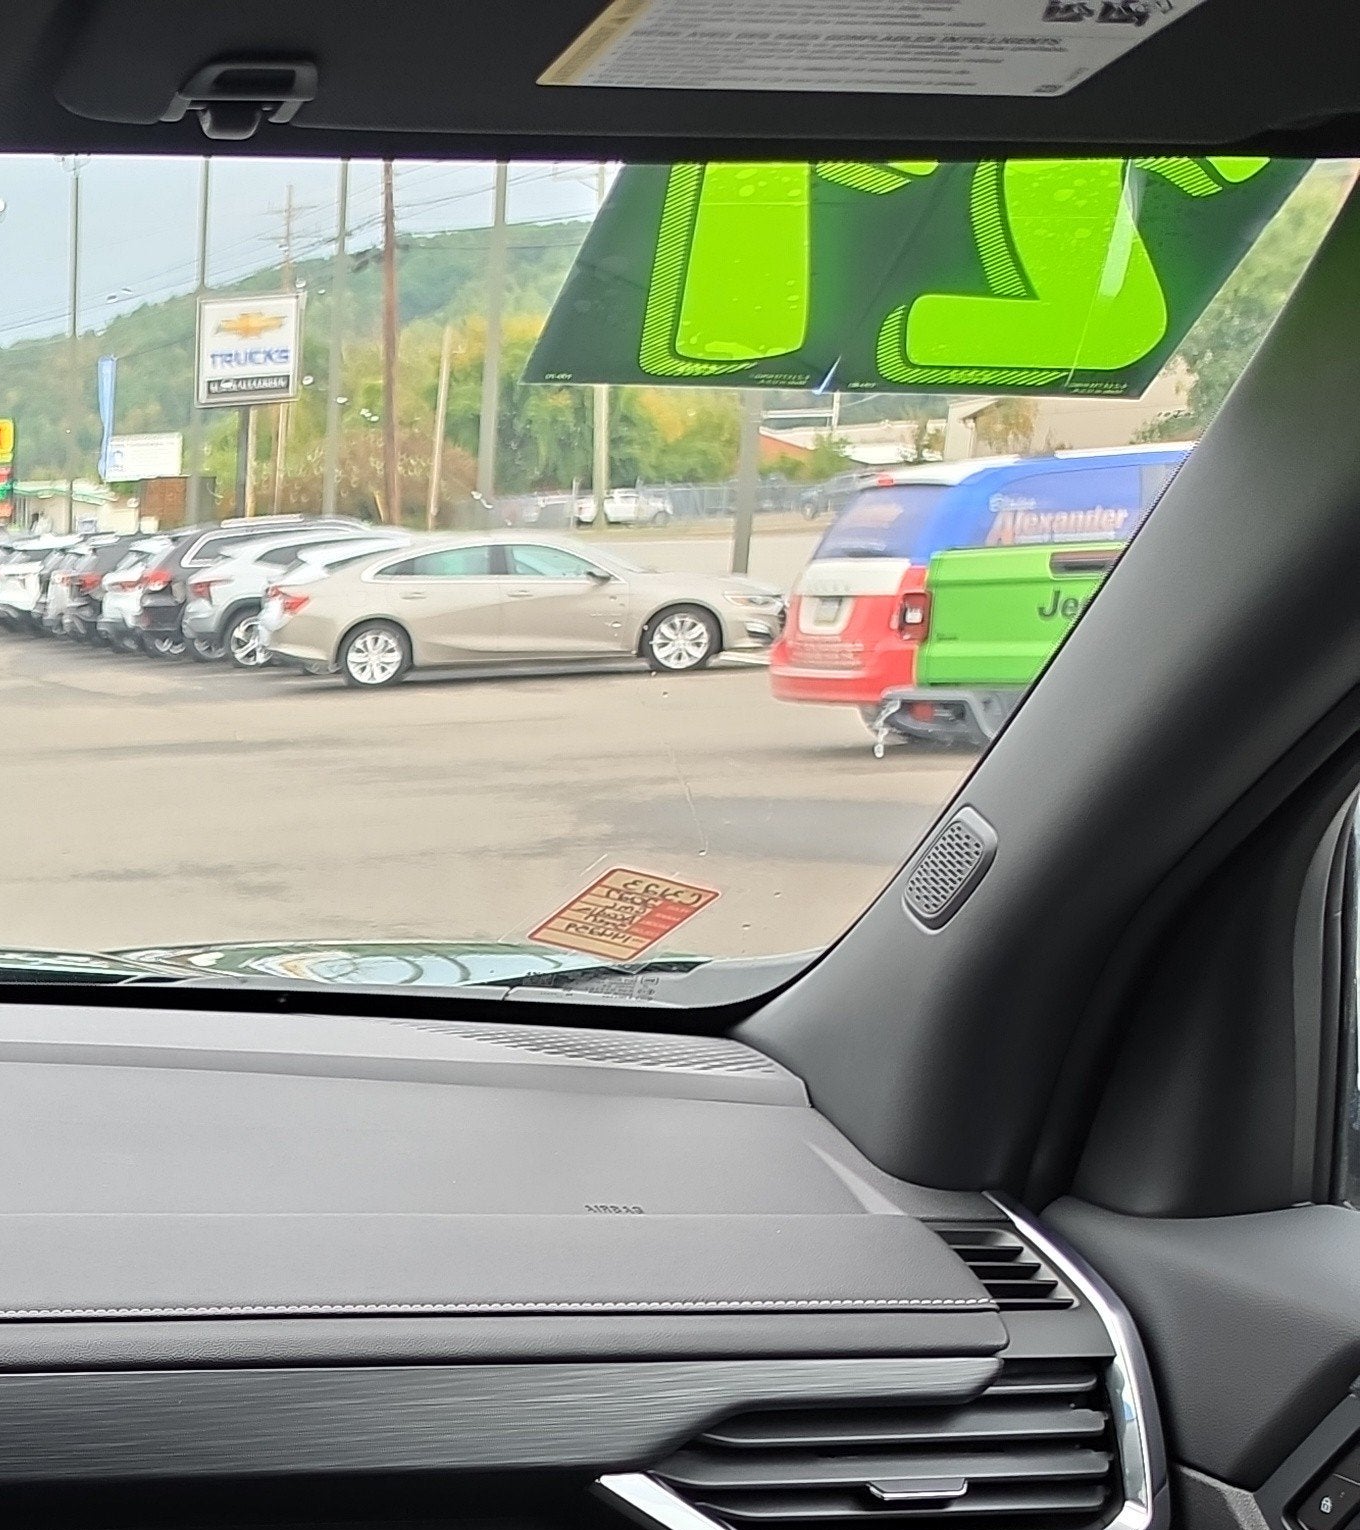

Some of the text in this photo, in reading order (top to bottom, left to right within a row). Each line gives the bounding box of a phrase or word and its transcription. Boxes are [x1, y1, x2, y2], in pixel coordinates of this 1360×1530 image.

[210, 348, 289, 367] TRUCKS
[1037, 588, 1080, 620] Je
[584, 1204, 645, 1214] AIRBAG
